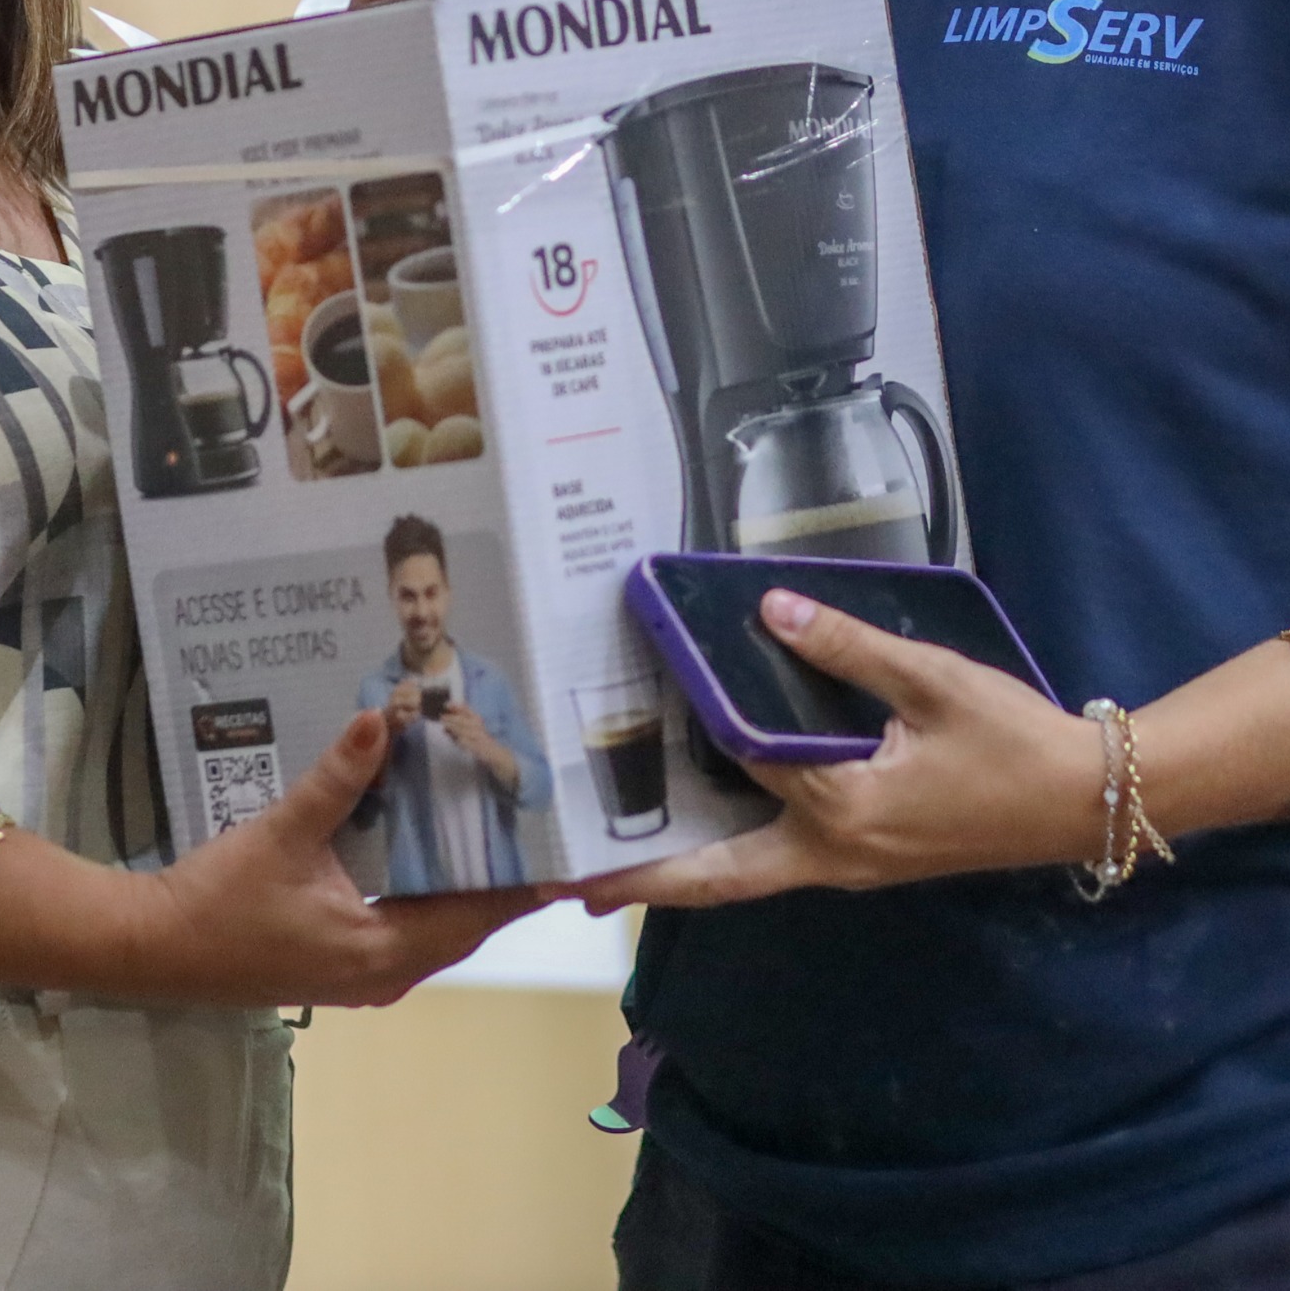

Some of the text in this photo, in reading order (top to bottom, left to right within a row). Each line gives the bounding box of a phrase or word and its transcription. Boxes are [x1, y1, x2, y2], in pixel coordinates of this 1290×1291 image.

[72, 42, 304, 127] MONDIAL
[1084, 53, 1200, 76] QUALIDADE EM SERVIÇOS
[531, 242, 577, 291] 18
[176, 590, 246, 626] ACESSE
[253, 587, 267, 619] E
[180, 628, 338, 675] NOVAS RECEITAS
